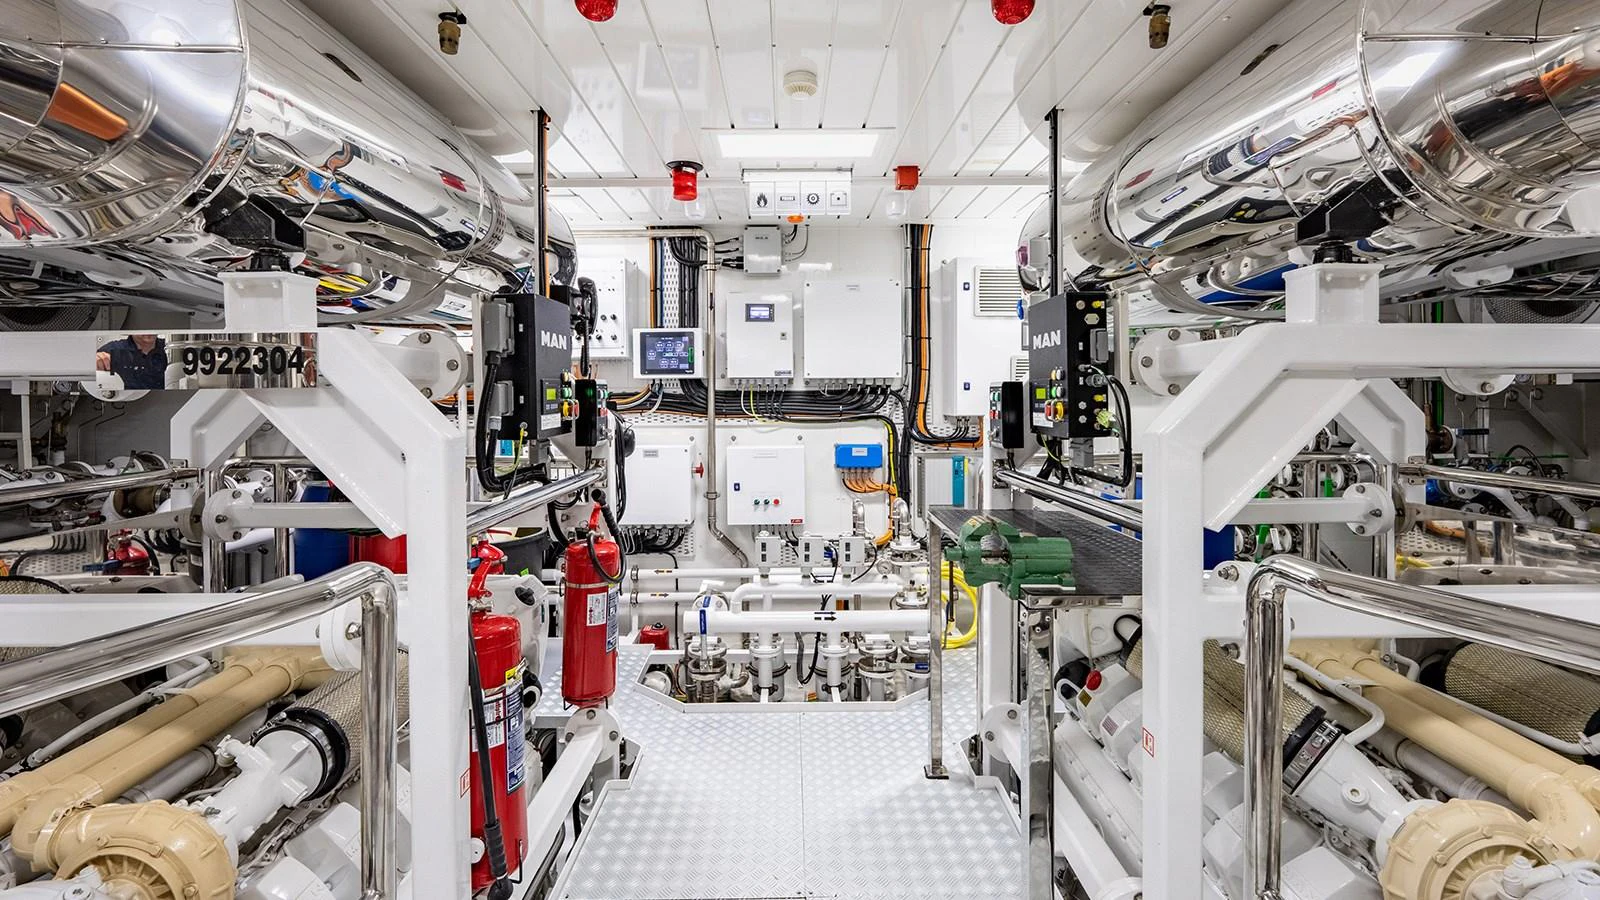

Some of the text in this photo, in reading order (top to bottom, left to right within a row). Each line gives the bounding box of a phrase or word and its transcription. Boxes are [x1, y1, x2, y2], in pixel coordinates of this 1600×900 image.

[541, 330, 567, 350] MAN
[1033, 329, 1060, 350] MAN
[182, 345, 305, 375] 9922304
